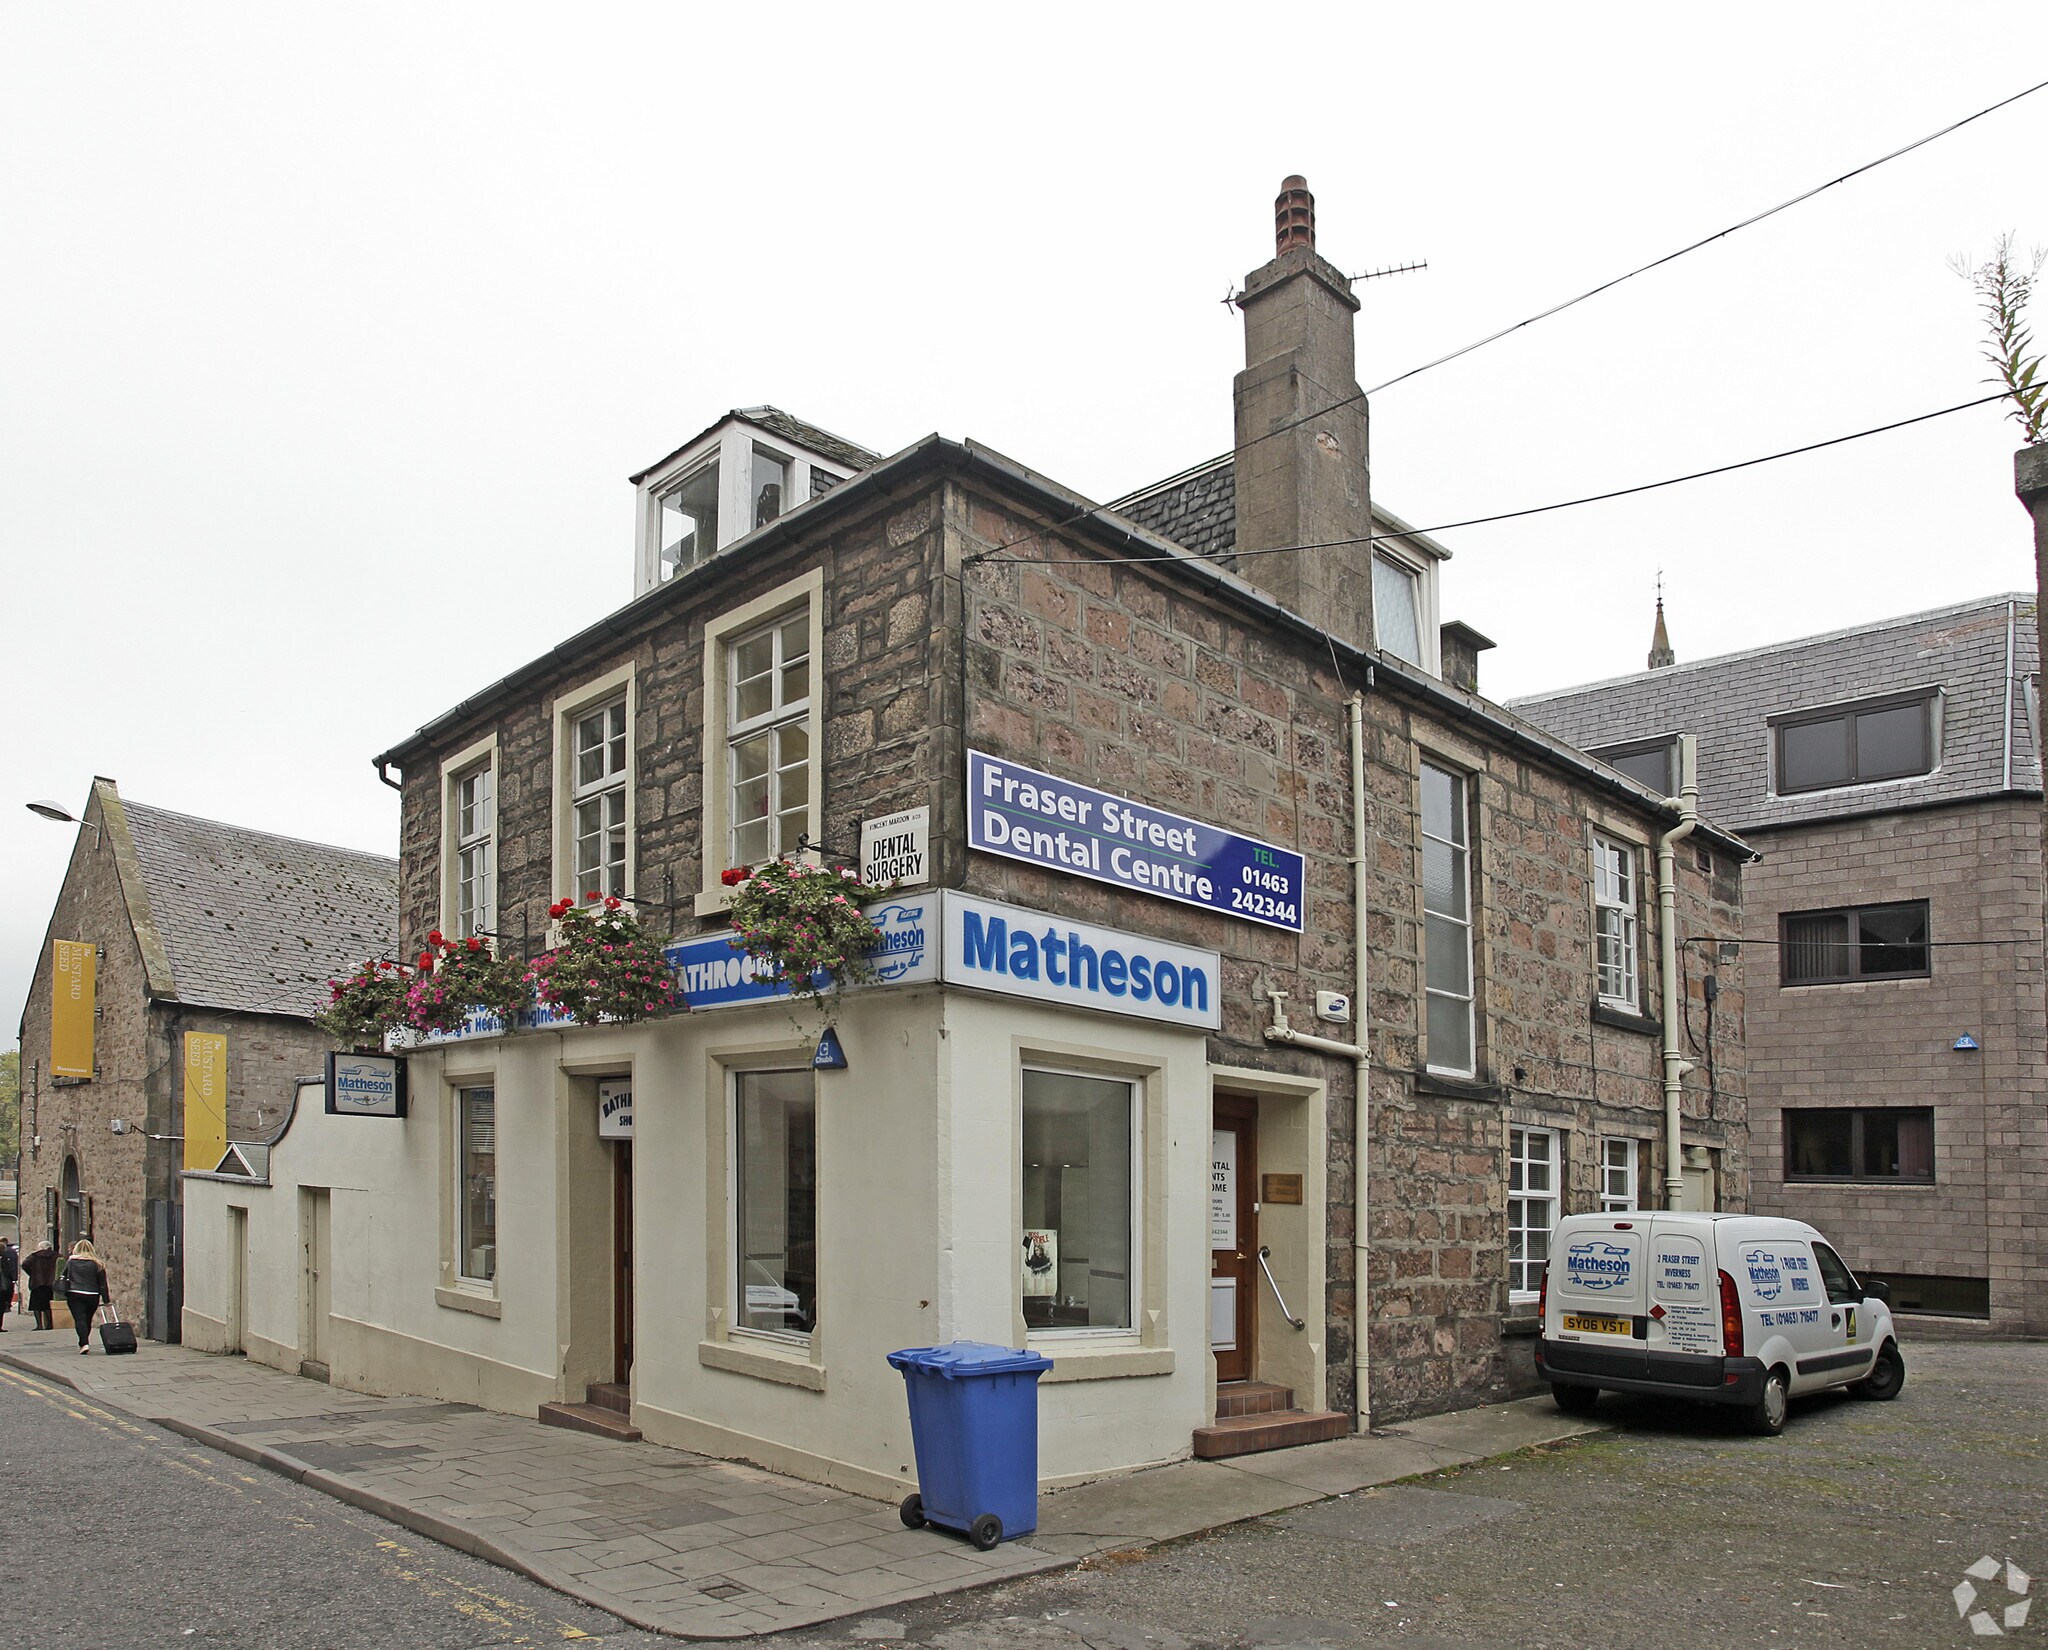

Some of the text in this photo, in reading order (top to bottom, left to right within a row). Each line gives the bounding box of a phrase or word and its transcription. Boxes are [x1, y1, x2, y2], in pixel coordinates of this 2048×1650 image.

[983, 763, 1197, 857] Fraser Street
[868, 821, 888, 832] VINCENT
[888, 815, 910, 827] MARDON
[873, 832, 917, 861] DENTAL
[983, 810, 1213, 900] Dental Centre
[1253, 847, 1280, 868] TEL.
[866, 853, 922, 884] SURGERY
[1242, 866, 1289, 895] 01463
[1231, 887, 1297, 924] 242344
[59, 944, 70, 972] SEED
[963, 910, 1209, 1012] Matheson
[71, 945, 82, 1000] MUSTARD
[190, 1037, 201, 1067] SEED
[202, 1039, 214, 1096] MUSTARD
[338, 1077, 393, 1091] Matheson
[603, 1093, 632, 1118] BATH
[619, 1115, 632, 1126] SHO
[1568, 1256, 1630, 1272] Matheson
[1662, 1254, 1680, 1264] FRASER
[1681, 1255, 1700, 1265] STREET
[1664, 1268, 1691, 1278] INVERNESS
[1748, 1266, 1781, 1281] Matheson
[1568, 1318, 1625, 1333] SY06 VST
[1776, 1312, 1799, 1325] (01463)
[1799, 1310, 1819, 1323] 716477
